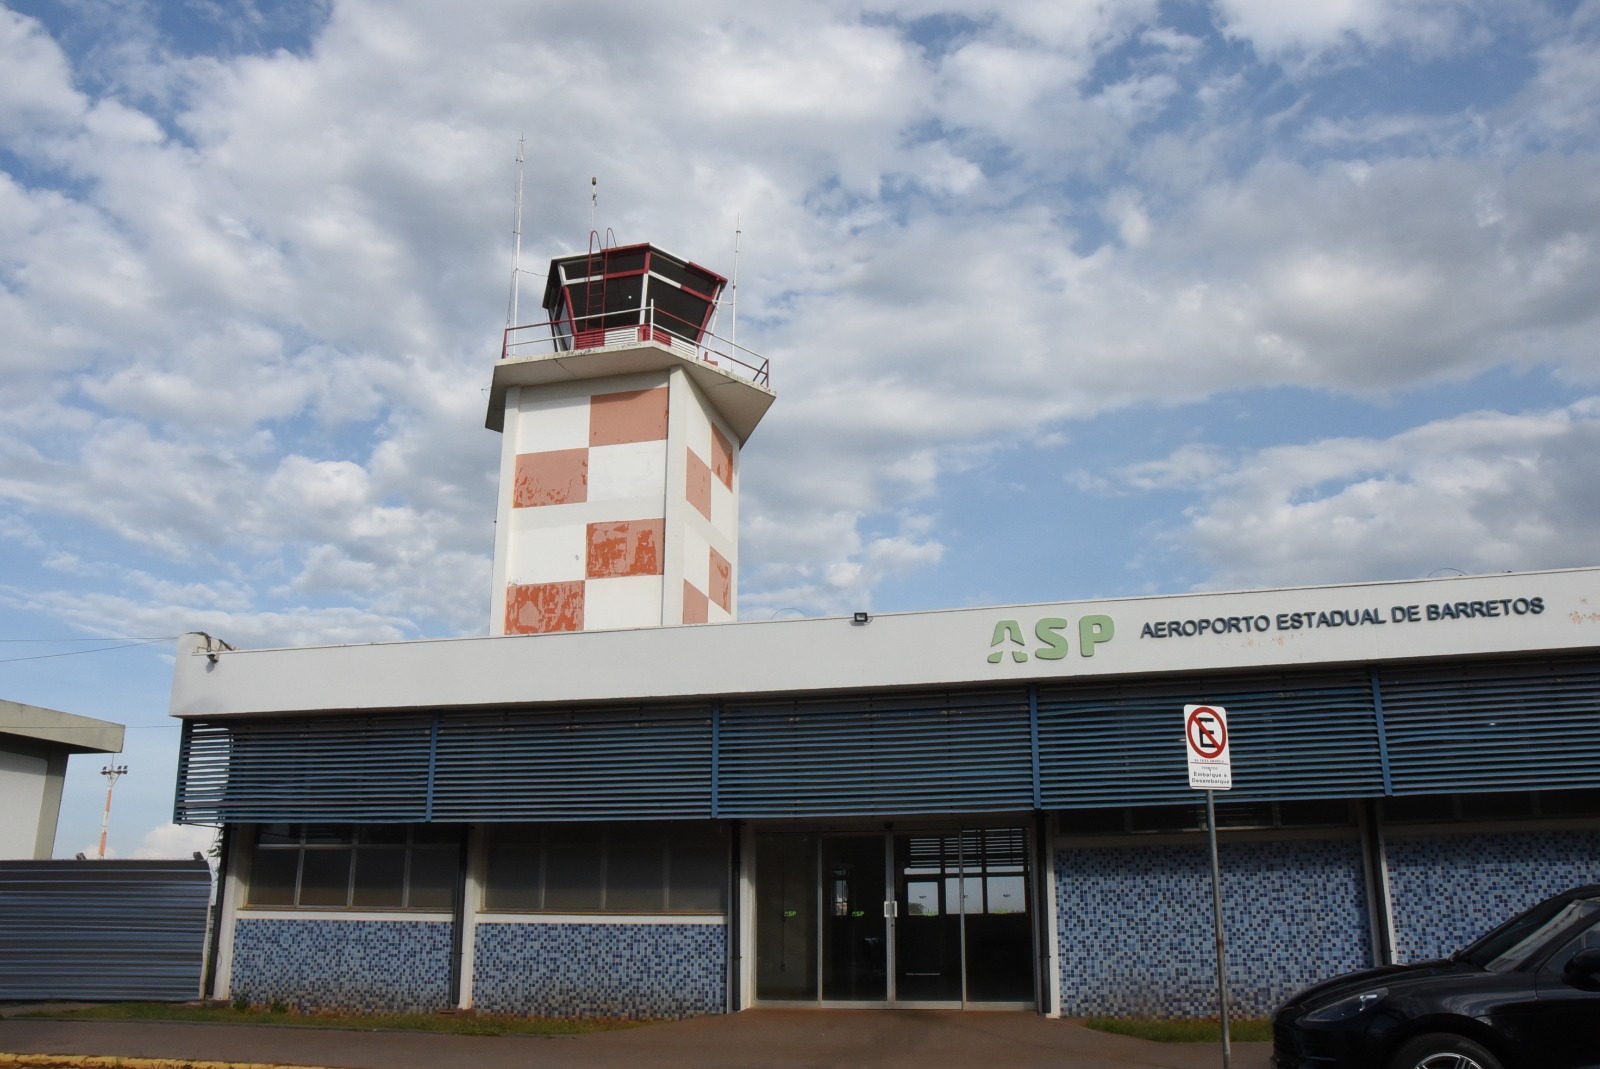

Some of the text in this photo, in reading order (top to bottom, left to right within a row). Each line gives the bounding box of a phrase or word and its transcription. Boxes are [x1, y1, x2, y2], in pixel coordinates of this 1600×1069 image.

[987, 614, 1115, 663] ASP
[1140, 597, 1545, 639] AEROPORTO ESTADUAL DE BARRETOS
